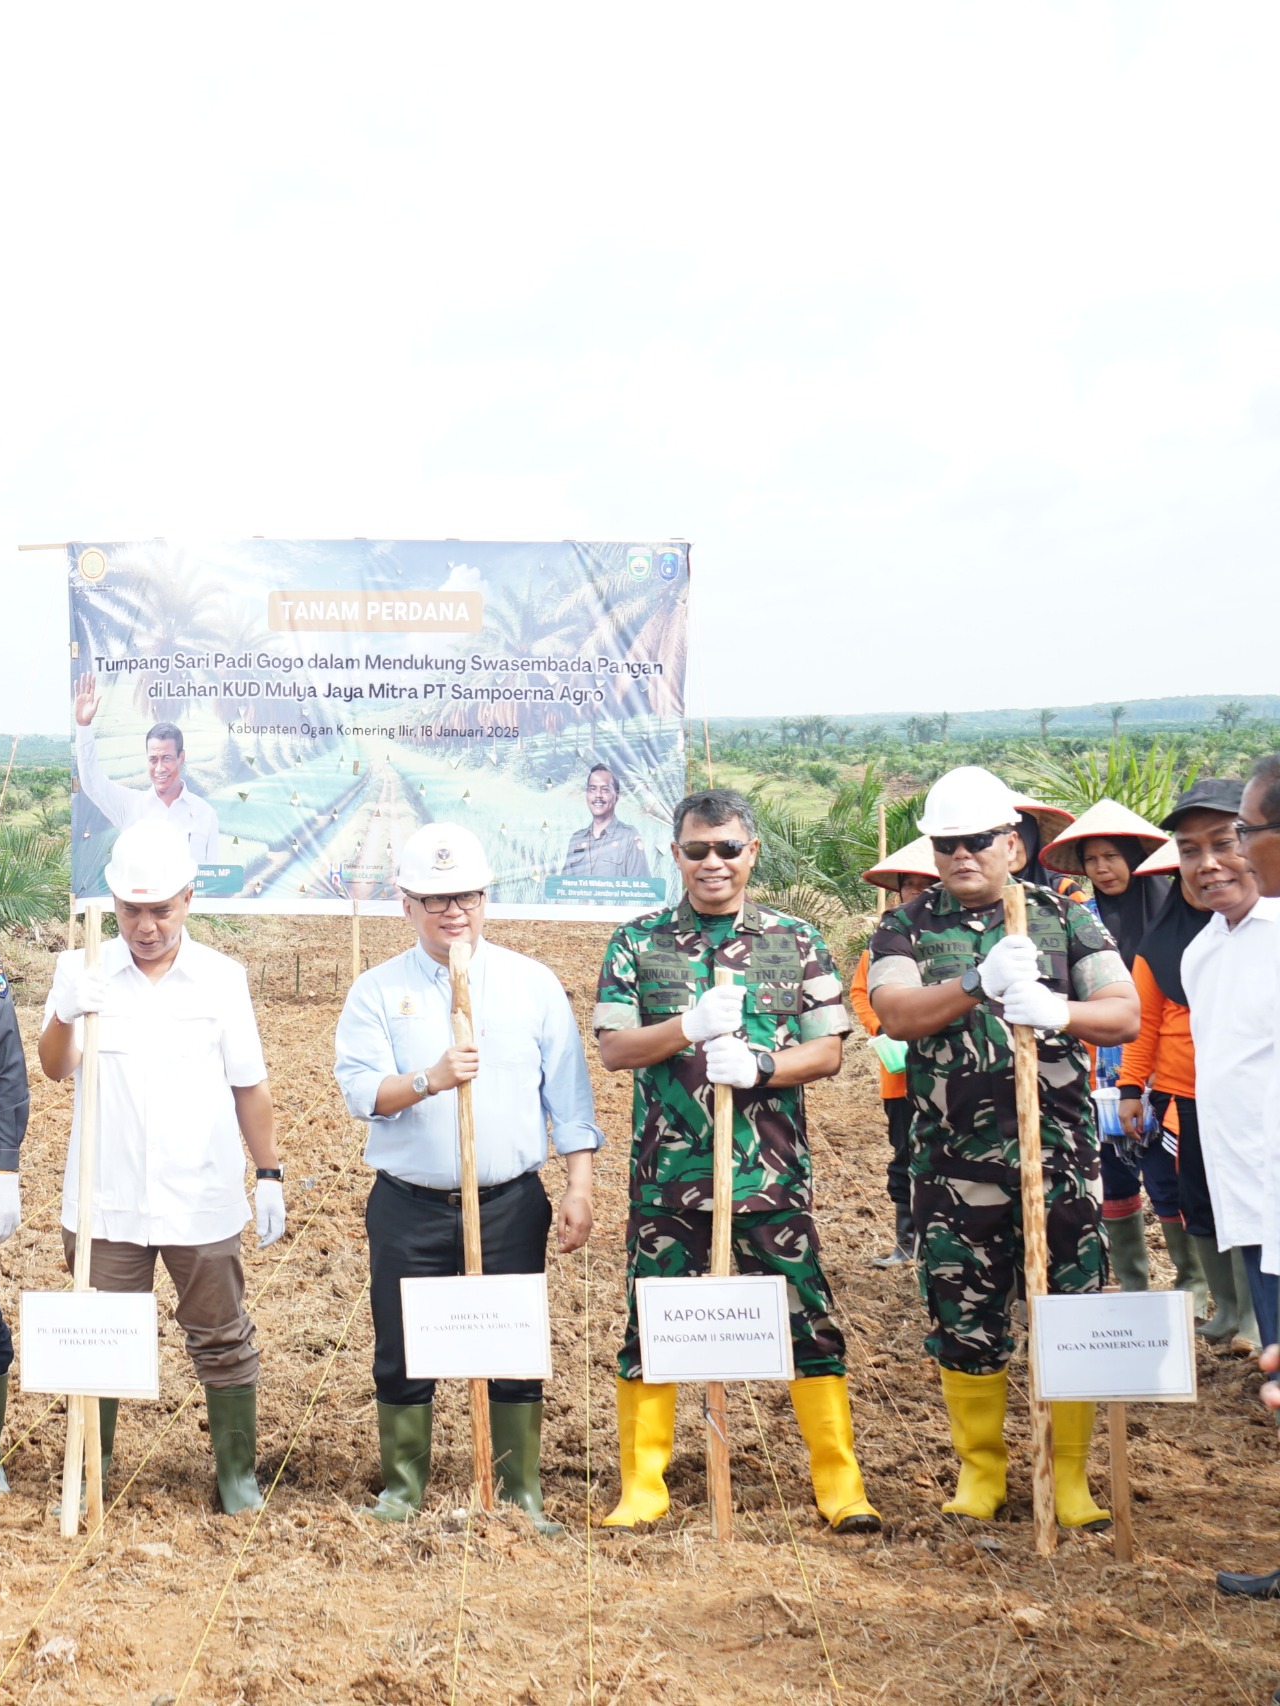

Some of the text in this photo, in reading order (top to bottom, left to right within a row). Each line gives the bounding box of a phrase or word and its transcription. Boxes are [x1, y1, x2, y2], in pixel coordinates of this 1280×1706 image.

[281, 602, 469, 621] TANAM PERDANA
[95, 653, 663, 679] Tumpang Sari Padi Gogo dalam Mendukung Swasembada Pangan
[148, 682, 604, 706] di Lahan KUD Mulya Jaya Mitra PT Sampoerna Agro
[228, 723, 519, 739] Kabupaten Ogan Komering Ilir, 16 Januari 2025
[218, 869, 231, 877] MP
[196, 880, 205, 888] RI
[593, 889, 619, 897] Jenderal
[621, 890, 656, 898] Perkebunan
[1039, 937, 1059, 948] AD
[754, 969, 797, 980] TNI AD
[664, 1307, 761, 1322] KAPOKSAHLI
[51, 1327, 97, 1335] DIREKTUR
[1091, 1329, 1133, 1339] DANDIM
[58, 1338, 119, 1346] PERKEBUNAN
[653, 1331, 775, 1343] PANGDAM II SRIWIJAYA
[1057, 1338, 1169, 1352] OGAN KOMERING ILIR
